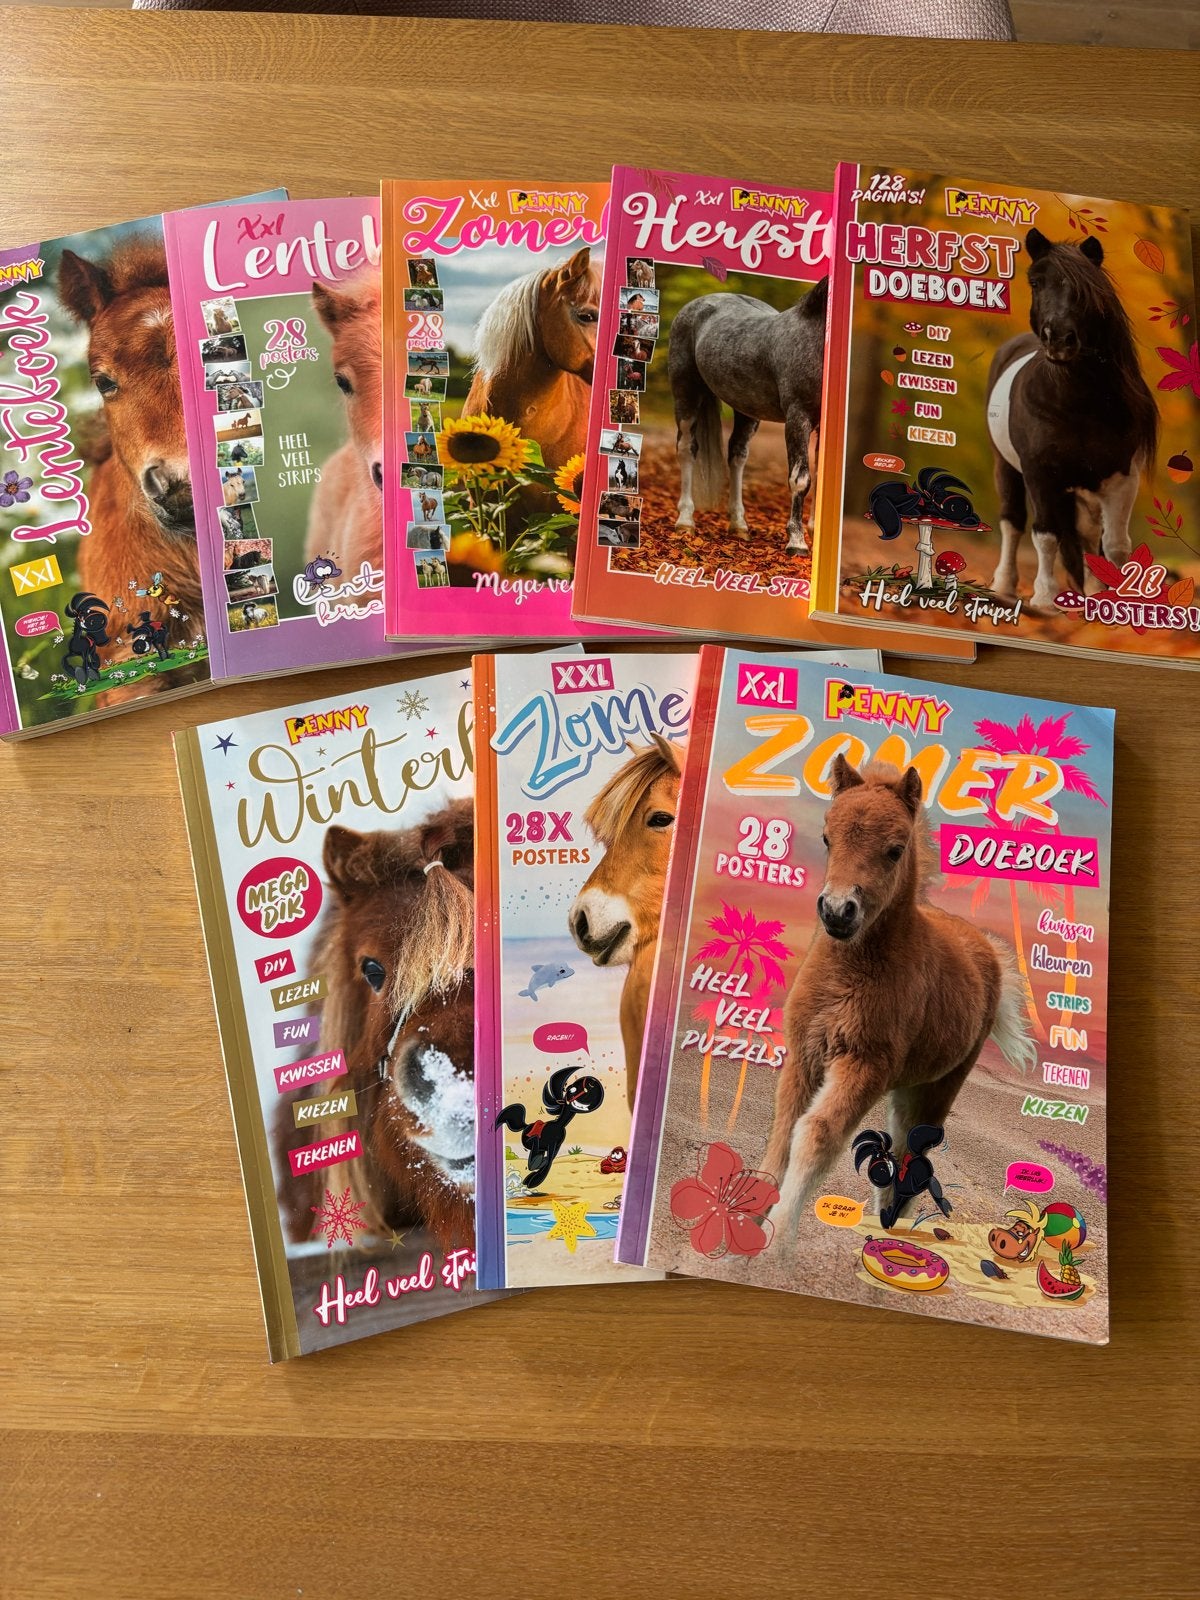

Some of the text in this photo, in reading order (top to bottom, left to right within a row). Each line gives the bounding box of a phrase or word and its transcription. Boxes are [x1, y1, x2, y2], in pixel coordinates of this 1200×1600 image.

[850, 188, 926, 206] PAGINA'S!
[869, 174, 906, 191] 128
[507, 189, 589, 216] PENNY
[730, 187, 809, 219] PENNY
[945, 187, 1040, 227] PENNY
[846, 221, 1020, 279] HERFST
[869, 269, 1008, 309] DOEBOEK
[263, 317, 306, 352] 28
[407, 313, 443, 339] 28
[927, 325, 951, 341] DIY
[259, 346, 319, 370] posters
[406, 337, 445, 350] posters
[912, 349, 954, 369] LEZEN
[898, 373, 957, 395] KWISSEN
[0, 291, 90, 543] Lenteboek
[915, 401, 942, 420] FUN
[278, 433, 311, 450] HEEL
[907, 425, 956, 447] KIEZEN
[281, 451, 313, 468] VEEL
[278, 467, 322, 488] STRIPS
[472, 571, 545, 605] Mega
[654, 562, 707, 587] HEEL
[713, 569, 764, 594] VEEL
[858, 580, 1023, 626] Heel veel strips!
[555, 663, 611, 690] XXL
[823, 677, 954, 739] PENNY
[284, 704, 370, 746] PENNY
[722, 713, 1065, 826] ZOMER
[505, 811, 574, 844] 28X
[737, 816, 793, 861] 28
[512, 848, 591, 866] POSTERS
[715, 853, 806, 888] POSTERS
[948, 833, 1096, 877] DOEBOEK
[245, 866, 309, 914] MEGA
[260, 893, 306, 933] DIK
[1037, 908, 1094, 943] kwissen
[264, 957, 287, 977] DIY
[1031, 943, 1093, 978] kleuren
[278, 979, 320, 1005] LEZEN
[689, 963, 751, 998] HEEL
[715, 998, 773, 1033] VEEL
[1046, 991, 1092, 1014] STRIPS
[283, 1022, 311, 1040] FUN
[546, 1033, 575, 1041] RACEN!!
[1050, 1024, 1088, 1051] FUN
[680, 1029, 787, 1067] PUZZELS
[279, 1053, 341, 1086] KWISSEN
[1042, 1062, 1090, 1090] TEKENEN
[297, 1096, 348, 1121] KIEZEN
[1021, 1094, 1089, 1125] KIEZEN
[294, 1135, 357, 1169] TEKENEN
[313, 1266, 382, 1327] Heel
[385, 1251, 436, 1299] veel
